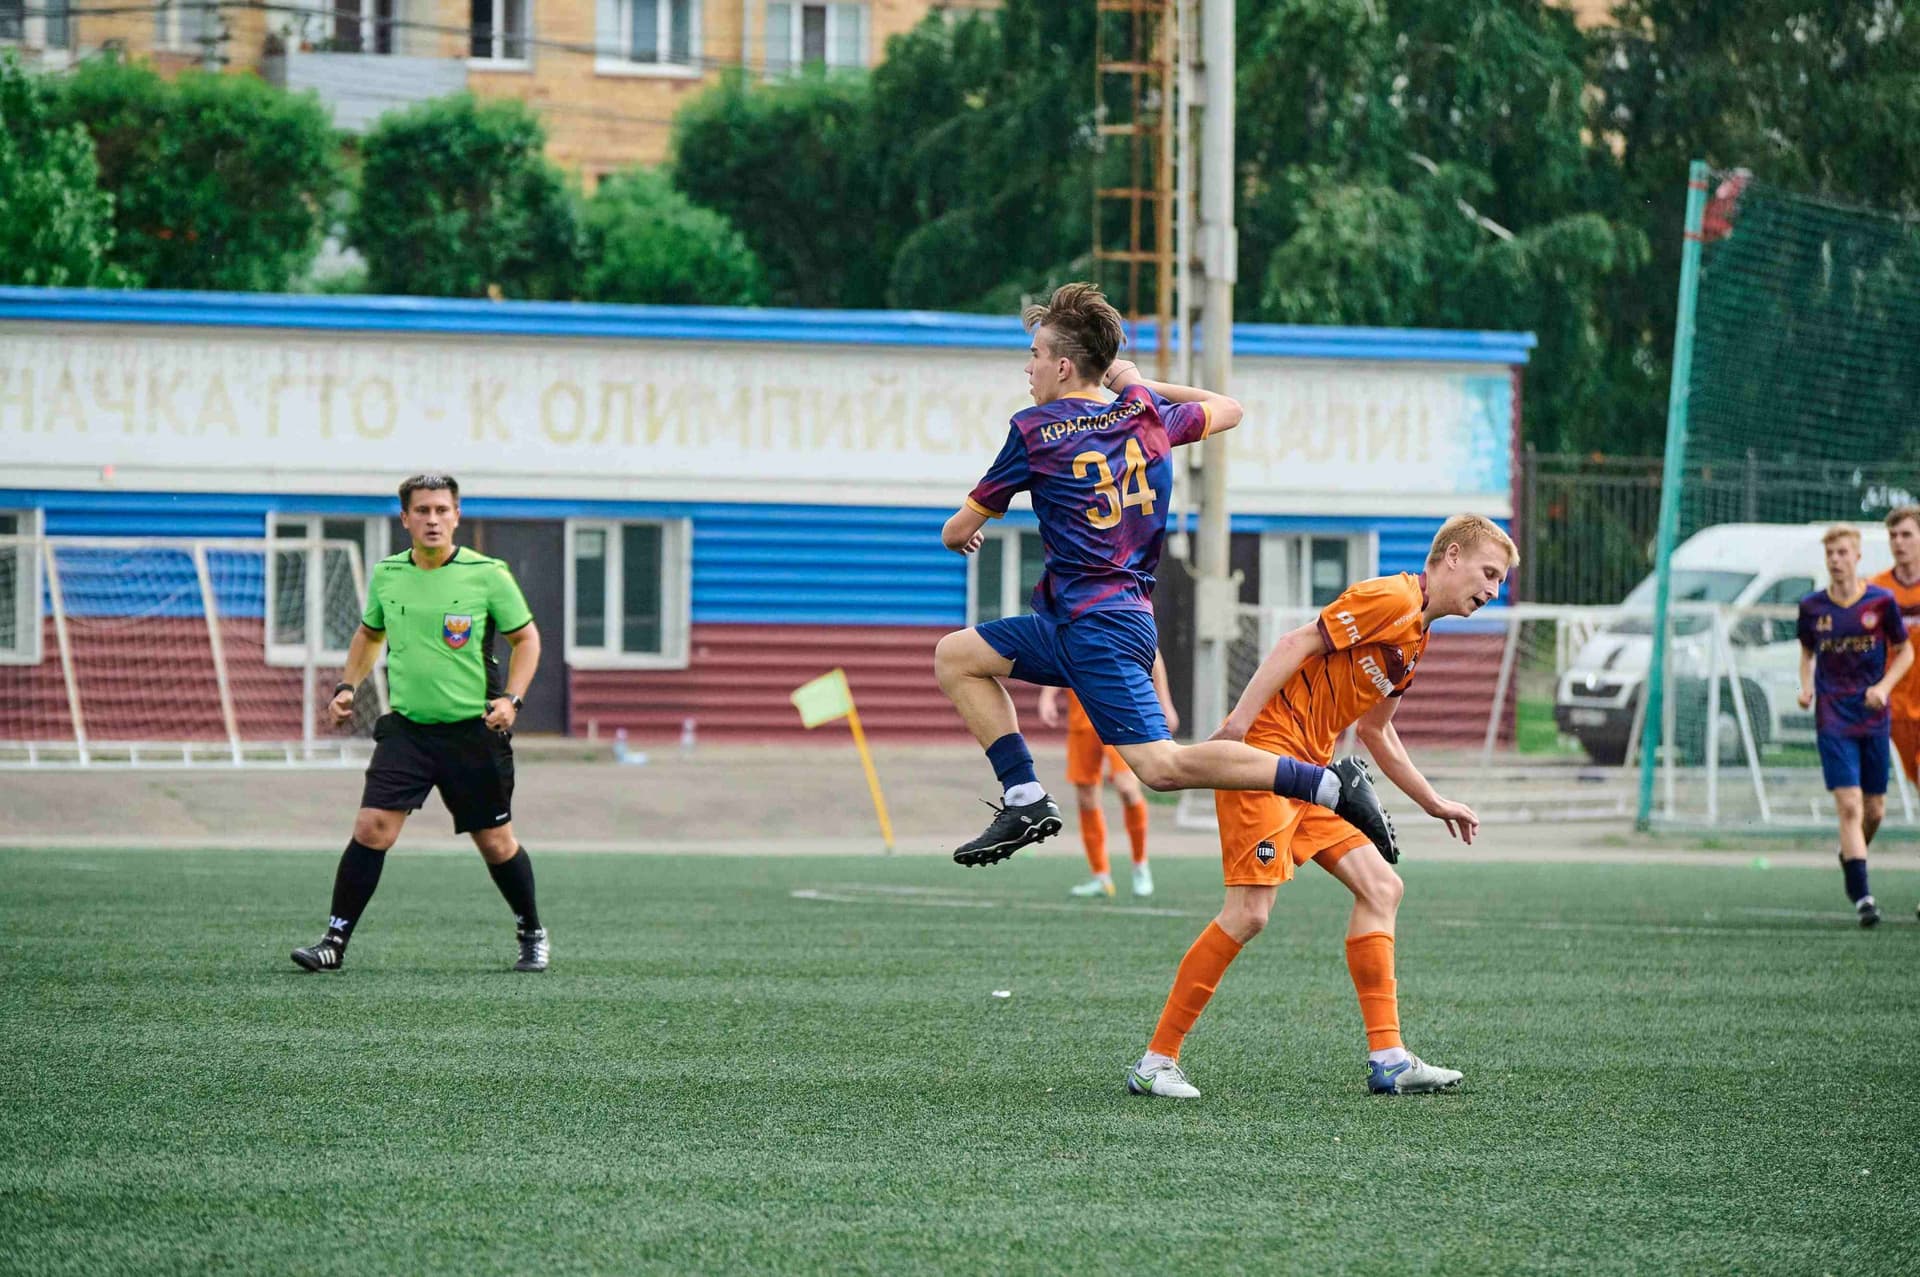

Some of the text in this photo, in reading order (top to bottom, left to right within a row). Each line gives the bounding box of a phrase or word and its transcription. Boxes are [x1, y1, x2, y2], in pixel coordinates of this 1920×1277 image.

[268, 373, 397, 440] ГТО
[470, 381, 510, 441] К
[1229, 399, 1432, 470] ДАЛИ!
[1072, 438, 1157, 530] 34
